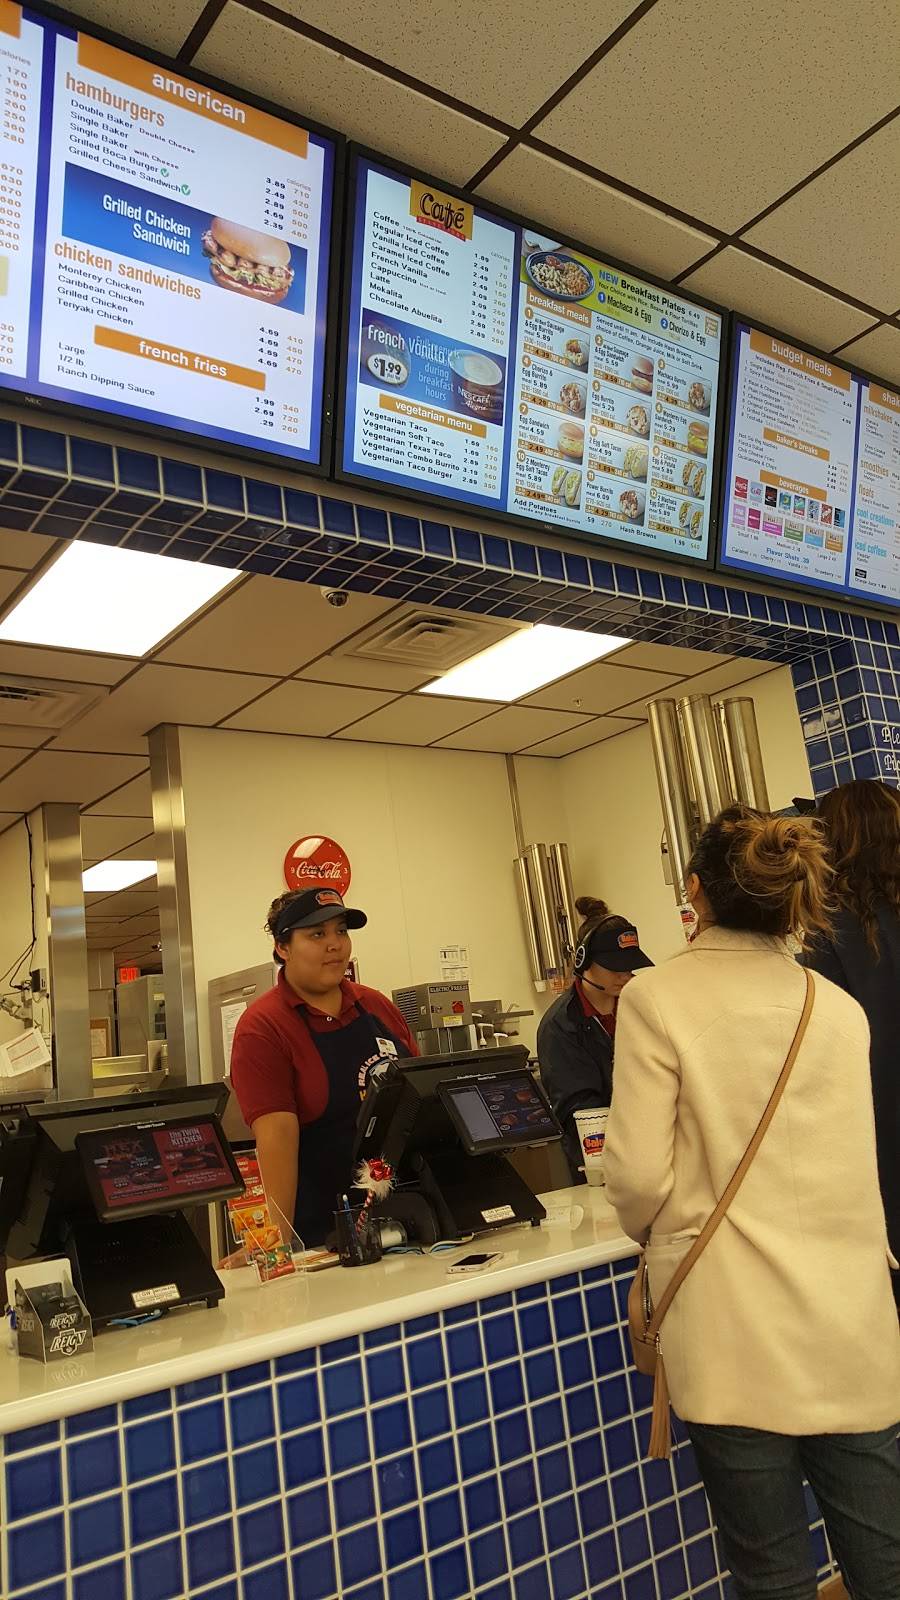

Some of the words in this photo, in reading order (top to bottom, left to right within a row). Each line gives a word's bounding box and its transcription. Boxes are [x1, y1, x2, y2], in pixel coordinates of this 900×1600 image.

[7, 66, 28, 80] 170
[66, 72, 165, 127] hamburgers
[152, 73, 246, 124] american
[71, 100, 104, 117] Double
[107, 113, 133, 129] Baker
[70, 111, 99, 128] Single
[102, 124, 129, 139] Baker
[70, 123, 98, 139] Single
[101, 135, 128, 150] Baker
[69, 134, 100, 151] Grilled
[103, 147, 126, 161] Boca
[129, 155, 159, 174] Burger
[69, 146, 99, 162] Grilled
[102, 157, 136, 176] Cheese
[140, 171, 181, 192] Sandwich
[266, 177, 285, 189] 3.89
[265, 188, 285, 199] 2.49
[265, 199, 284, 210] 2.89
[420, 192, 464, 229] Café
[103, 194, 142, 221] Grilled
[145, 209, 191, 238] Chicken
[264, 209, 284, 220] 4.69
[373, 211, 400, 226] Coffee
[264, 219, 283, 230] 2.39
[133, 224, 190, 255] Sandwich
[373, 221, 404, 239] Regular
[406, 234, 422, 246] Iced
[425, 243, 450, 256] Coffee
[373, 231, 400, 247] Vanilla
[402, 242, 418, 254] Iced
[421, 251, 445, 265] Coffee
[371, 252, 399, 267] French
[401, 263, 428, 278] Vanilla
[372, 241, 405, 260] Caramel
[407, 254, 423, 266] Iced
[426, 263, 450, 277] Coffee
[474, 263, 489, 272] 2.49
[54, 242, 113, 272] chicken
[118, 262, 201, 300] sandwiches
[58, 263, 103, 283] Monterey
[105, 279, 142, 295] Chicken
[370, 272, 390, 285] Latte
[371, 262, 417, 284] Cappuccino
[473, 272, 488, 281] 2.49
[370, 282, 403, 299] Mokalita
[473, 282, 488, 290] 2.49
[599, 270, 619, 286] NEW
[620, 279, 661, 303] Breakfast
[662, 298, 686, 315] Plates
[58, 286, 89, 303] Grilled
[91, 295, 128, 313] Chicken
[109, 289, 145, 307] Chicken
[472, 301, 487, 310] 3.09
[57, 298, 94, 314] Teriyaki
[97, 309, 134, 325] Chicken
[369, 292, 409, 312] Chocolate
[412, 307, 442, 324] Abuelita
[471, 310, 486, 319] 3.09
[529, 292, 566, 316] breakfast
[566, 308, 589, 324] meals
[634, 307, 639, 317] &
[640, 309, 652, 324] Egg
[259, 326, 279, 337] 4.69
[368, 324, 405, 350] French
[697, 333, 706, 346] Egg
[58, 342, 85, 356] Large
[259, 337, 278, 347] 4.69
[59, 353, 73, 365] 1/2
[139, 341, 189, 366] french
[193, 356, 228, 377] fries
[258, 347, 278, 358] 4.69
[771, 340, 804, 364] budget
[806, 358, 832, 376] meals
[257, 357, 278, 368] 4.69
[374, 358, 401, 377] $1.99
[424, 363, 449, 379] during
[57, 365, 88, 381] Ranch
[90, 373, 125, 390] Dipping
[128, 382, 155, 396] Sauce
[418, 372, 454, 392] breakfast
[256, 396, 275, 407] 1.99
[425, 388, 446, 401] hours
[254, 407, 274, 418] 2.69
[363, 408, 406, 427] Vegetarian
[409, 423, 428, 432] Taco
[395, 401, 444, 423] vegetarian
[448, 417, 472, 431] menu
[520, 415, 528, 425] Egg
[864, 405, 892, 424] milkshakes
[363, 419, 406, 436] Vegetarian
[408, 432, 423, 442] Soft
[427, 437, 444, 447] Taco
[362, 429, 405, 447] Vegetarian
[408, 442, 430, 454] Texas
[434, 449, 451, 459] Taco
[776, 434, 797, 448] baker's
[798, 441, 818, 455] breaks
[362, 439, 405, 456] Vegetarian
[407, 452, 433, 464] Combo
[436, 459, 460, 471] Burrito
[362, 449, 404, 467] Vegetarian
[407, 462, 425, 472] Taco
[428, 467, 452, 479] Burger
[861, 459, 888, 476] smoothies
[528, 474, 542, 482] 5.89
[779, 478, 809, 495] beverages
[514, 498, 527, 507] Add
[529, 502, 556, 514] Potatoes
[620, 526, 635, 535] Hash
[637, 531, 656, 539] Browns
[297, 861, 342, 879] Coca-Cola
[120, 968, 138, 983] EXIT
[171, 1135, 202, 1145] KITCHEN
[53, 1333, 85, 1349] REIGN
